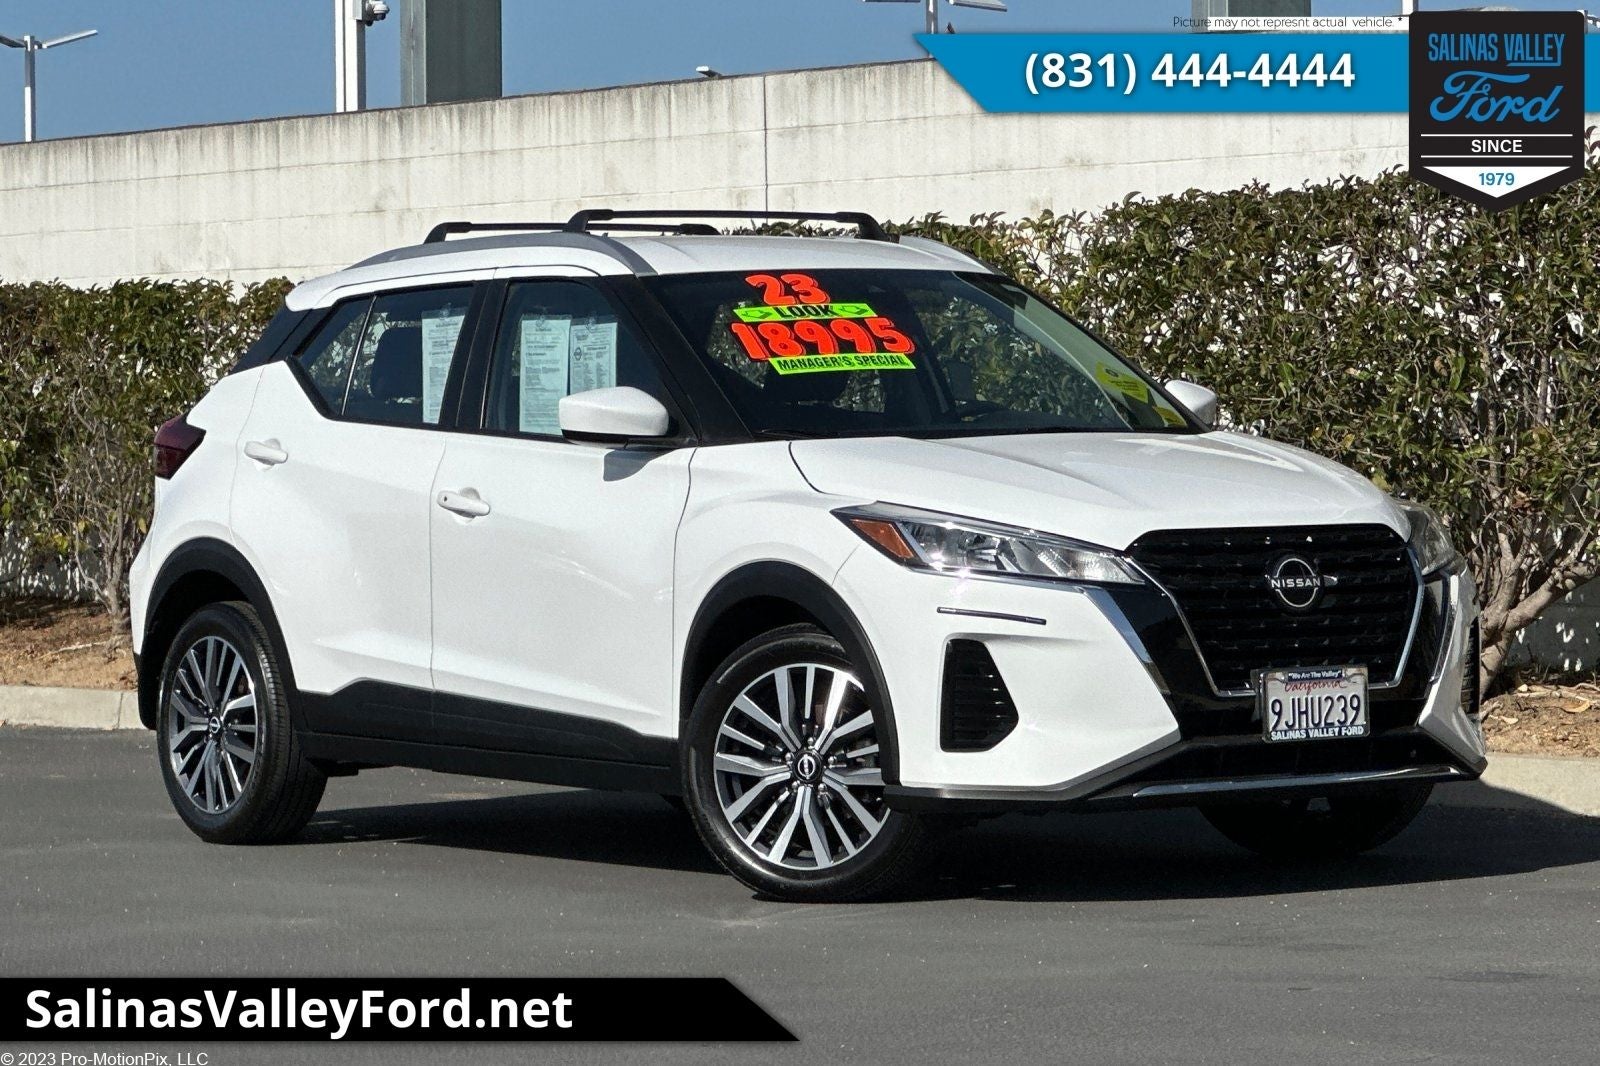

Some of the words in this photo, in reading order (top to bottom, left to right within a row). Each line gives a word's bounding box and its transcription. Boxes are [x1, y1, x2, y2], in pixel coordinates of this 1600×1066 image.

[745, 273, 831, 306] 23
[773, 304, 840, 318] LOOK
[731, 316, 916, 361] 18995
[777, 356, 853, 371] MANAGER'S
[852, 354, 910, 367] SPECIAL
[1271, 577, 1320, 588] NISSAN
[1270, 693, 1361, 731] 9JHU239
[1271, 729, 1306, 741] SALINAS
[1308, 727, 1339, 738] VALLEY
[1341, 725, 1364, 736] FORD
